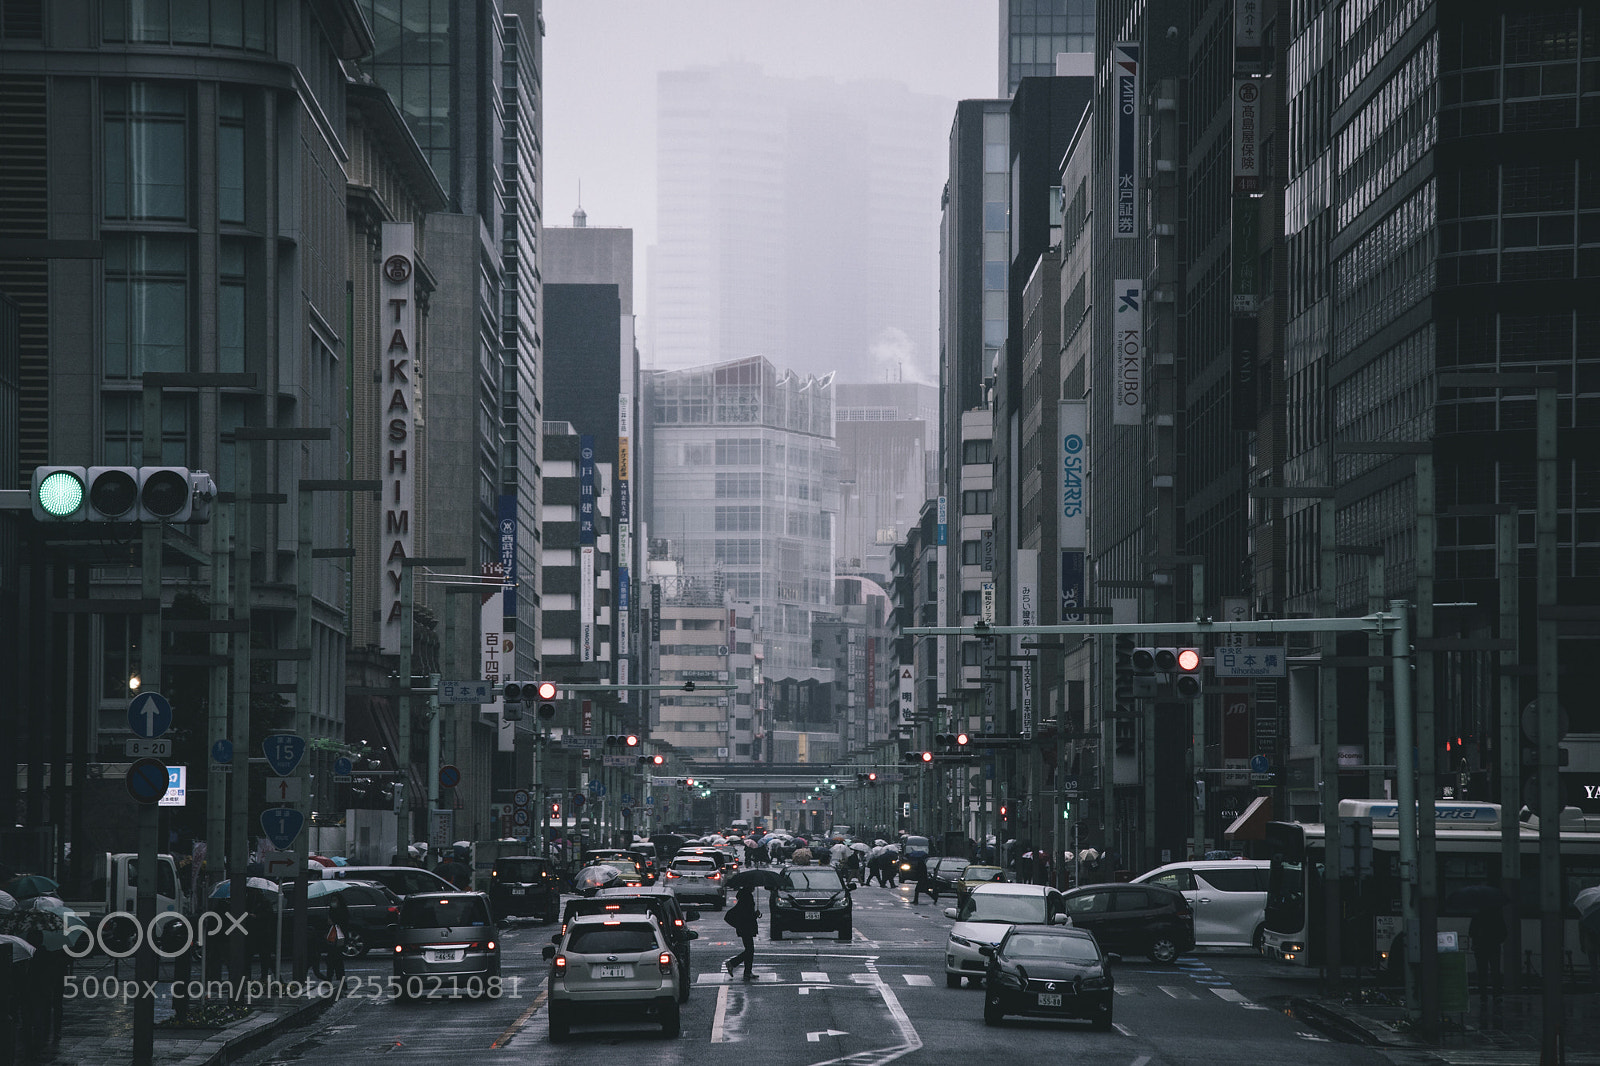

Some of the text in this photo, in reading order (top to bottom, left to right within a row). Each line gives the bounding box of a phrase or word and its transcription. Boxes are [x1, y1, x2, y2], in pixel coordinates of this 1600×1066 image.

[1122, 78, 1134, 115] MITO
[1120, 173, 1134, 232] 水戸証券
[1123, 330, 1139, 406] KOKUBO
[387, 299, 410, 625] TAKASHIMAYA
[581, 466, 593, 532] 戸田建設
[1064, 456, 1082, 518] STARTS
[481, 562, 503, 574] 114
[502, 534, 514, 590] 西武ポリマ
[485, 632, 499, 702] 百十四銀
[1224, 654, 1278, 667] 日本橋
[444, 686, 486, 697] 日本橋
[1226, 703, 1246, 716] JTB
[275, 745, 294, 760] 15
[278, 819, 285, 834] 1
[1388, 808, 1478, 819] Hrid
